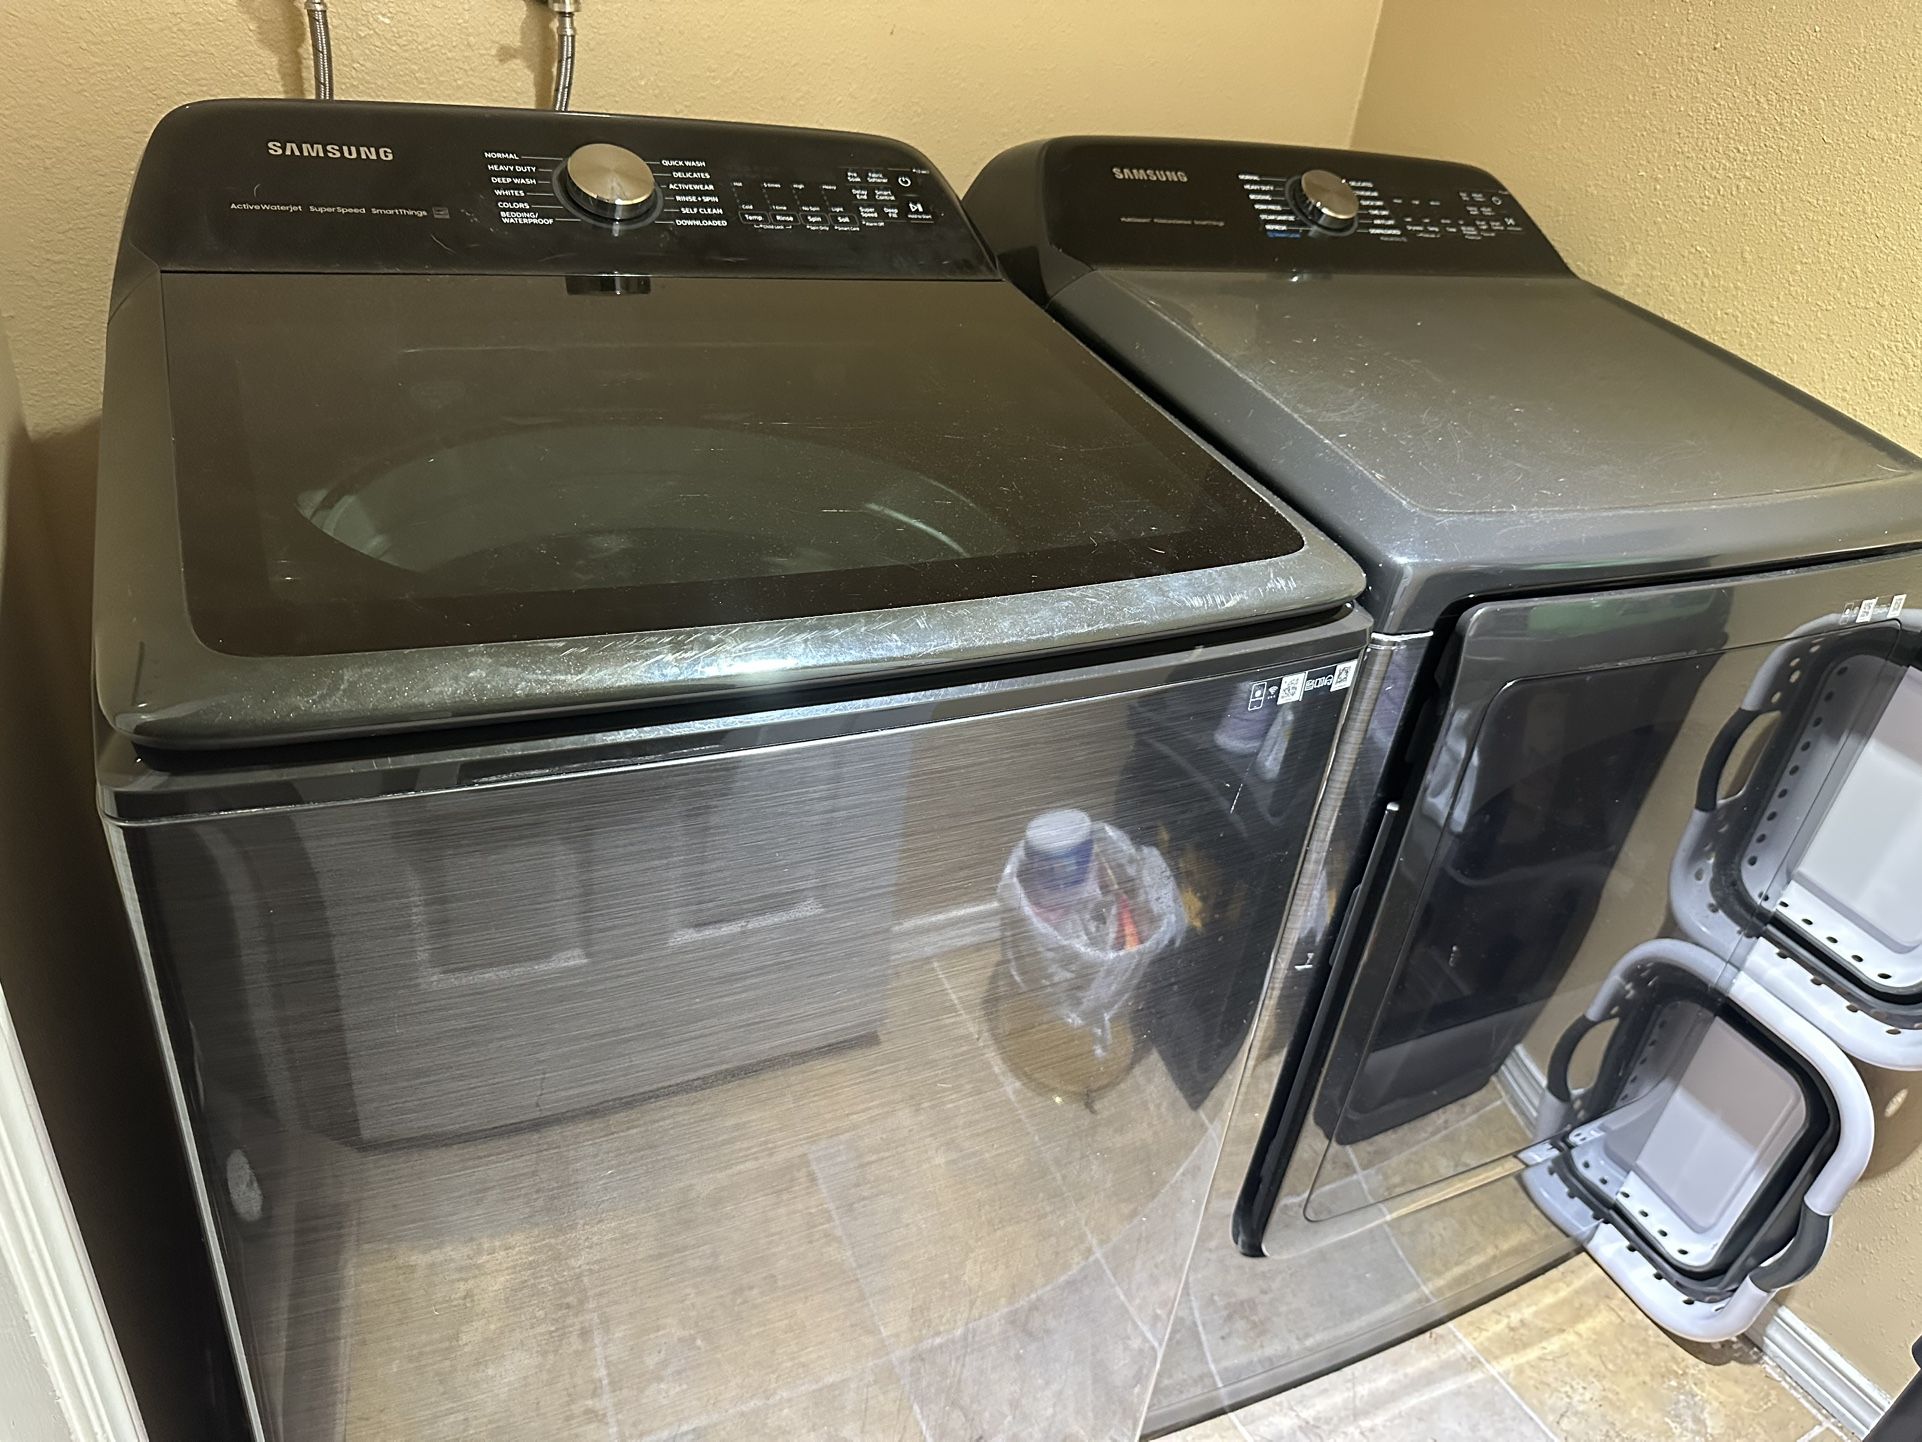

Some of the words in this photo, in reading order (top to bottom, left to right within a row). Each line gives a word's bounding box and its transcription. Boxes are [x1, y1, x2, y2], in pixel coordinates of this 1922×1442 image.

[268, 141, 394, 161] SAMSUNG
[484, 152, 519, 160] NORMAL
[1112, 167, 1188, 182] SAMSUNG
[371, 208, 428, 217] SmartThings
